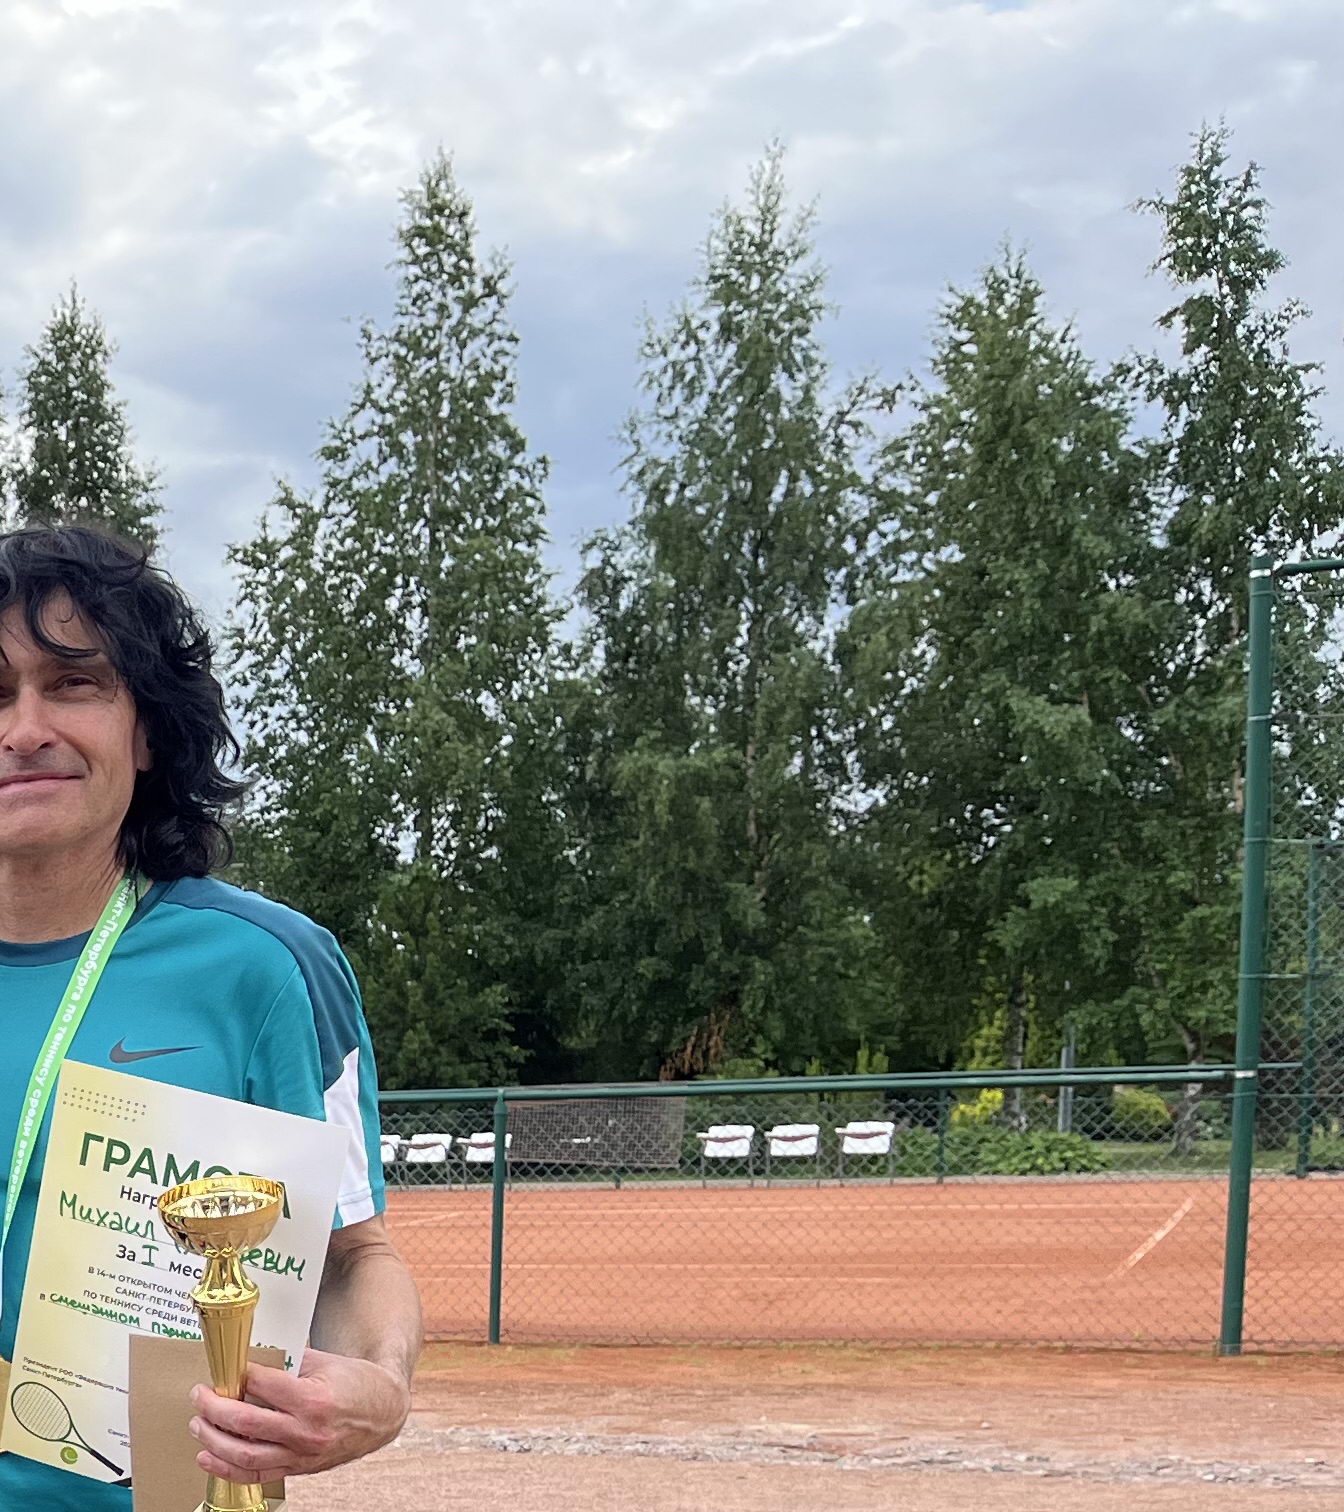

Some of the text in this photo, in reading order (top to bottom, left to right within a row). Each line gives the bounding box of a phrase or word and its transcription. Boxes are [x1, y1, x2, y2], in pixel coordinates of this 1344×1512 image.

[63, 1005, 76, 1022] по
[34, 1026, 68, 1086] теннису
[22, 1090, 42, 1137] среди
[59, 1190, 156, 1242] Михаил
[115, 1244, 136, 1262] За
[118, 1274, 173, 1296] ОТКРЫТОМ
[83, 1289, 97, 1300] ПО
[99, 1292, 145, 1312] ТЕННИСУ
[145, 1306, 178, 1325] СРЕДИ
